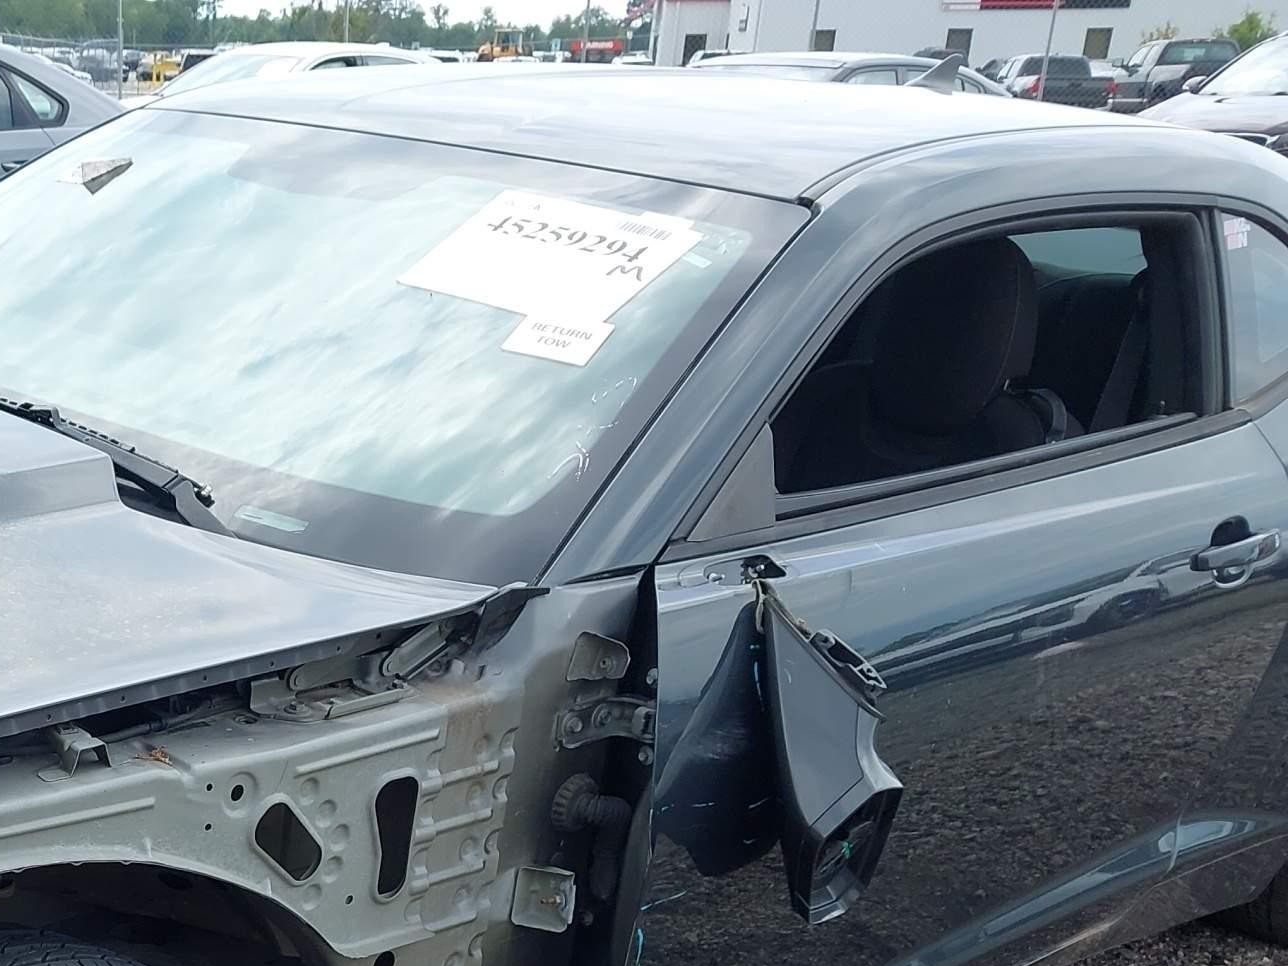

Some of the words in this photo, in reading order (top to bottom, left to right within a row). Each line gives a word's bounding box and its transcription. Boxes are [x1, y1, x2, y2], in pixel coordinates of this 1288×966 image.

[487, 215, 649, 263] 45259294
[531, 322, 594, 341] RETURN
[536, 335, 571, 349] TOW
